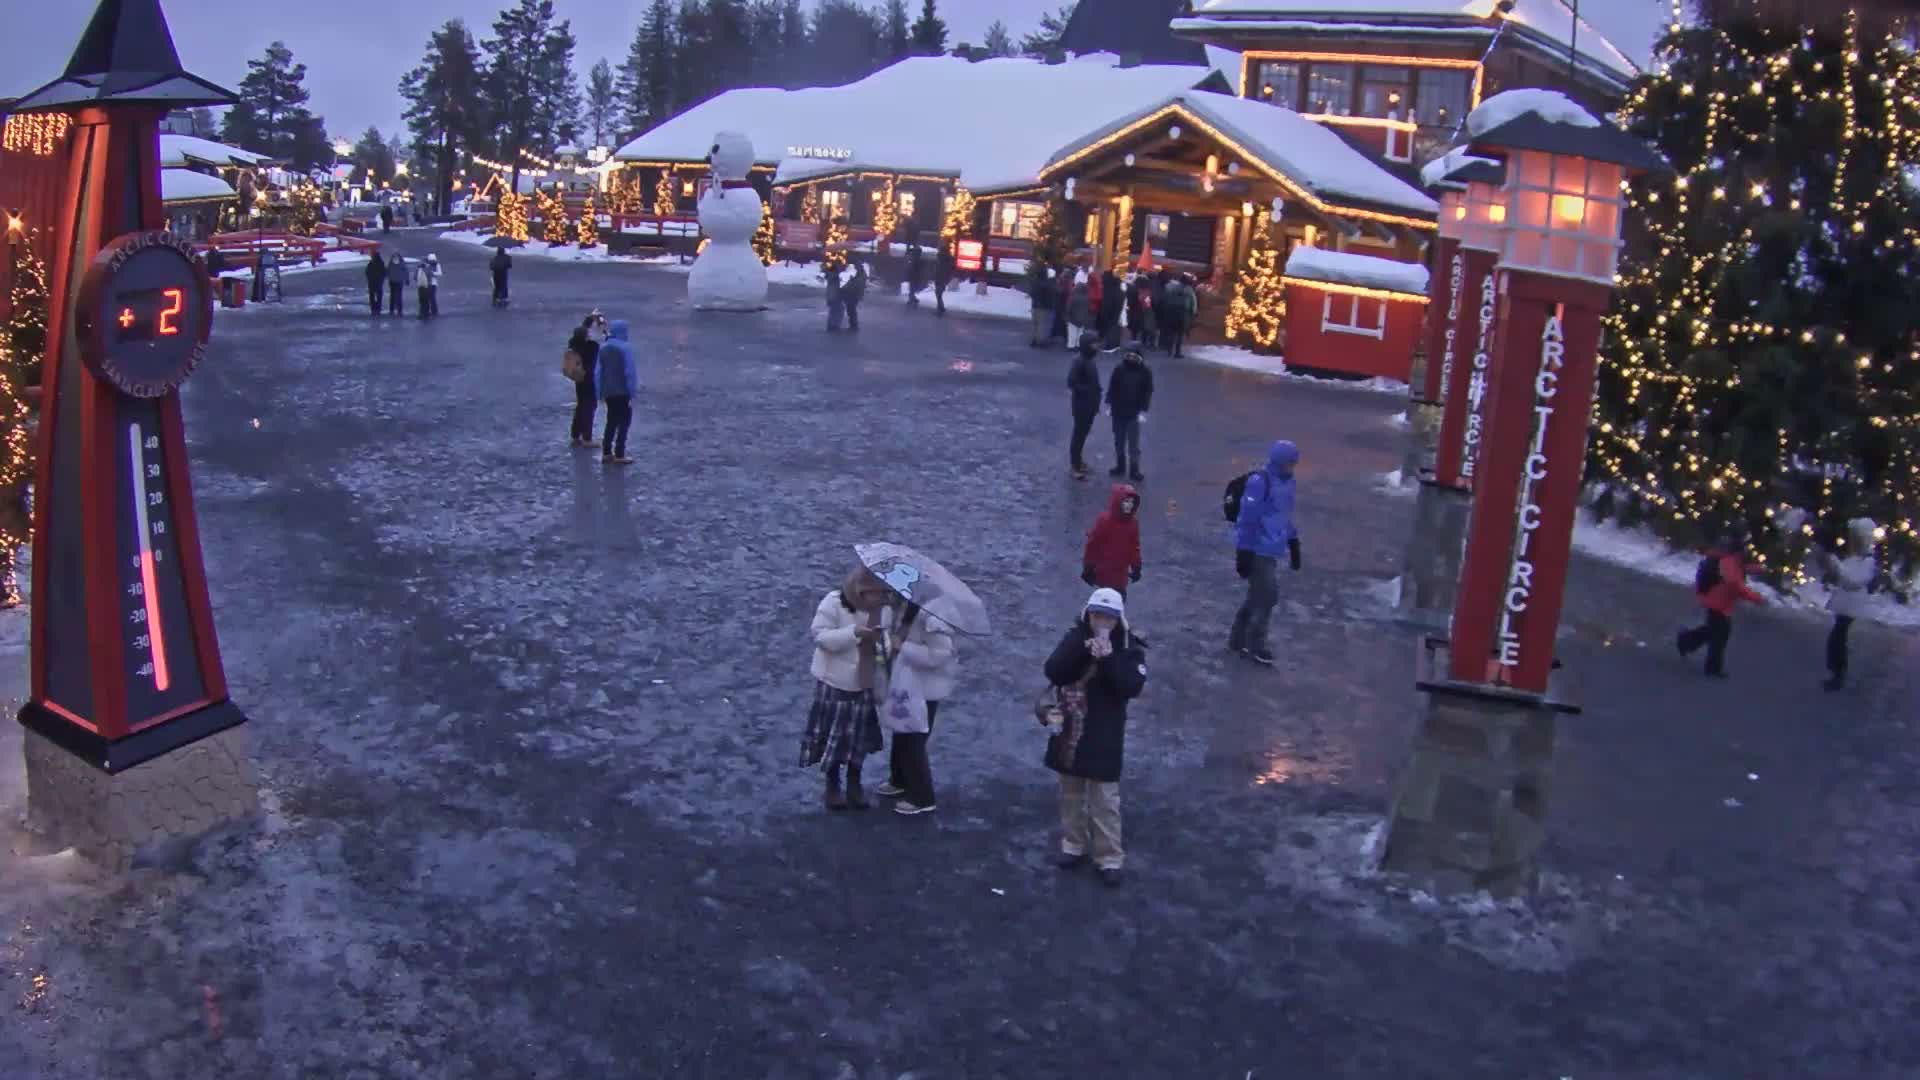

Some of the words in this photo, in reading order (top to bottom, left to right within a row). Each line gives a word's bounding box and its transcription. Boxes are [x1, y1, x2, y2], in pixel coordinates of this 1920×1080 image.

[1448, 254, 1463, 321] ARCTIC
[159, 288, 182, 333] 2
[1474, 274, 1496, 369] ARCTIC
[1441, 328, 1457, 396] CIRCLE
[1525, 316, 1564, 480] ARCTIC
[145, 435, 159, 449] 40
[147, 464, 160, 478] 30
[149, 491, 163, 506] 20
[152, 519, 165, 535] 10
[133, 555, 140, 569] 0
[155, 550, 163, 563] 0
[1500, 503, 1542, 666] CIRCLE
